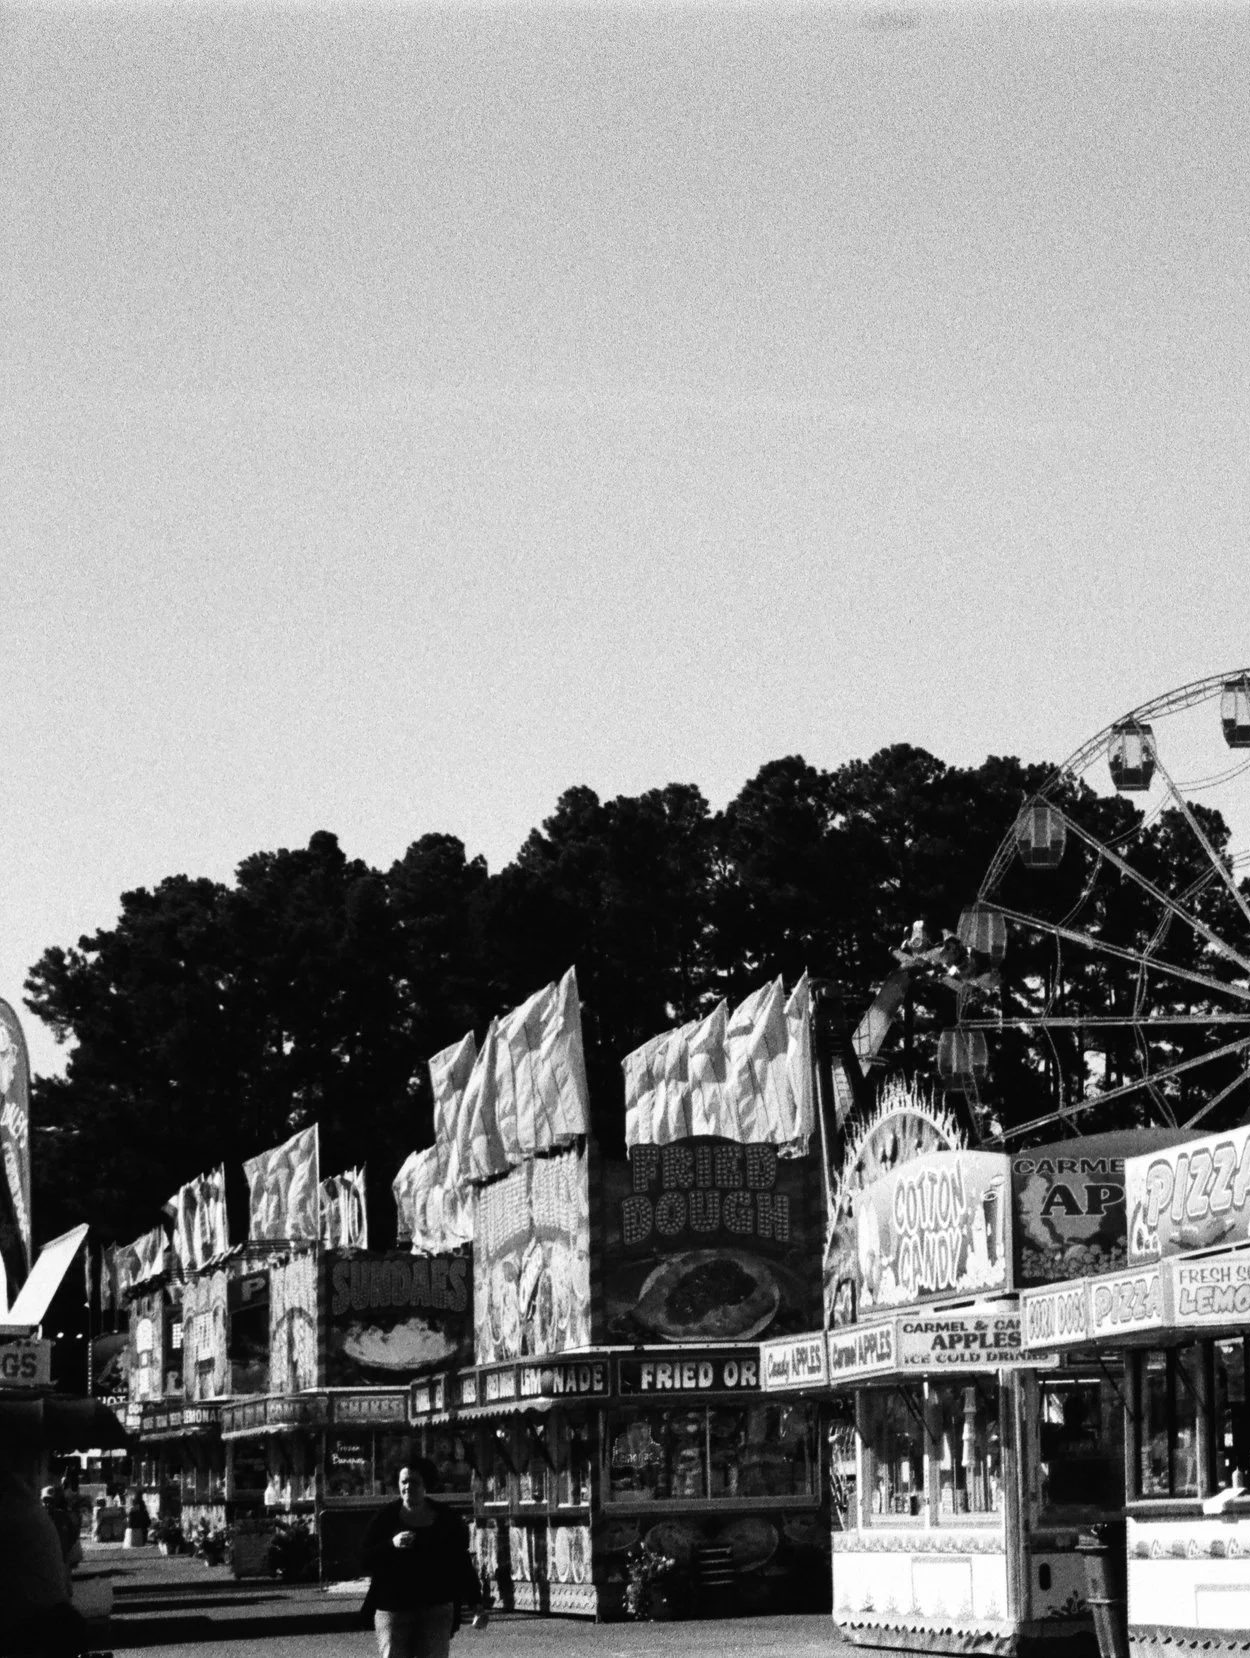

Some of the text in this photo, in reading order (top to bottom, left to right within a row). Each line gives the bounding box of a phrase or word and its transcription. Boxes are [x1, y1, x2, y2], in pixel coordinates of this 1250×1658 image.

[632, 1144, 777, 1192] FRIED
[893, 1158, 967, 1235] COTTON
[622, 1190, 790, 1245] DOUGH
[898, 1226, 962, 1299] CANDY
[1179, 1266, 1231, 1285] FRESH
[332, 1259, 468, 1315] SUNDAES
[903, 1321, 969, 1334] CARMEL
[974, 1319, 990, 1332] &
[931, 1331, 1022, 1351] APPLES
[792, 1343, 822, 1376] APPLES
[858, 1329, 892, 1367] APPLES
[904, 1354, 931, 1365] ICE
[935, 1352, 980, 1364] COLD
[640, 1360, 757, 1390] FRIED OR
